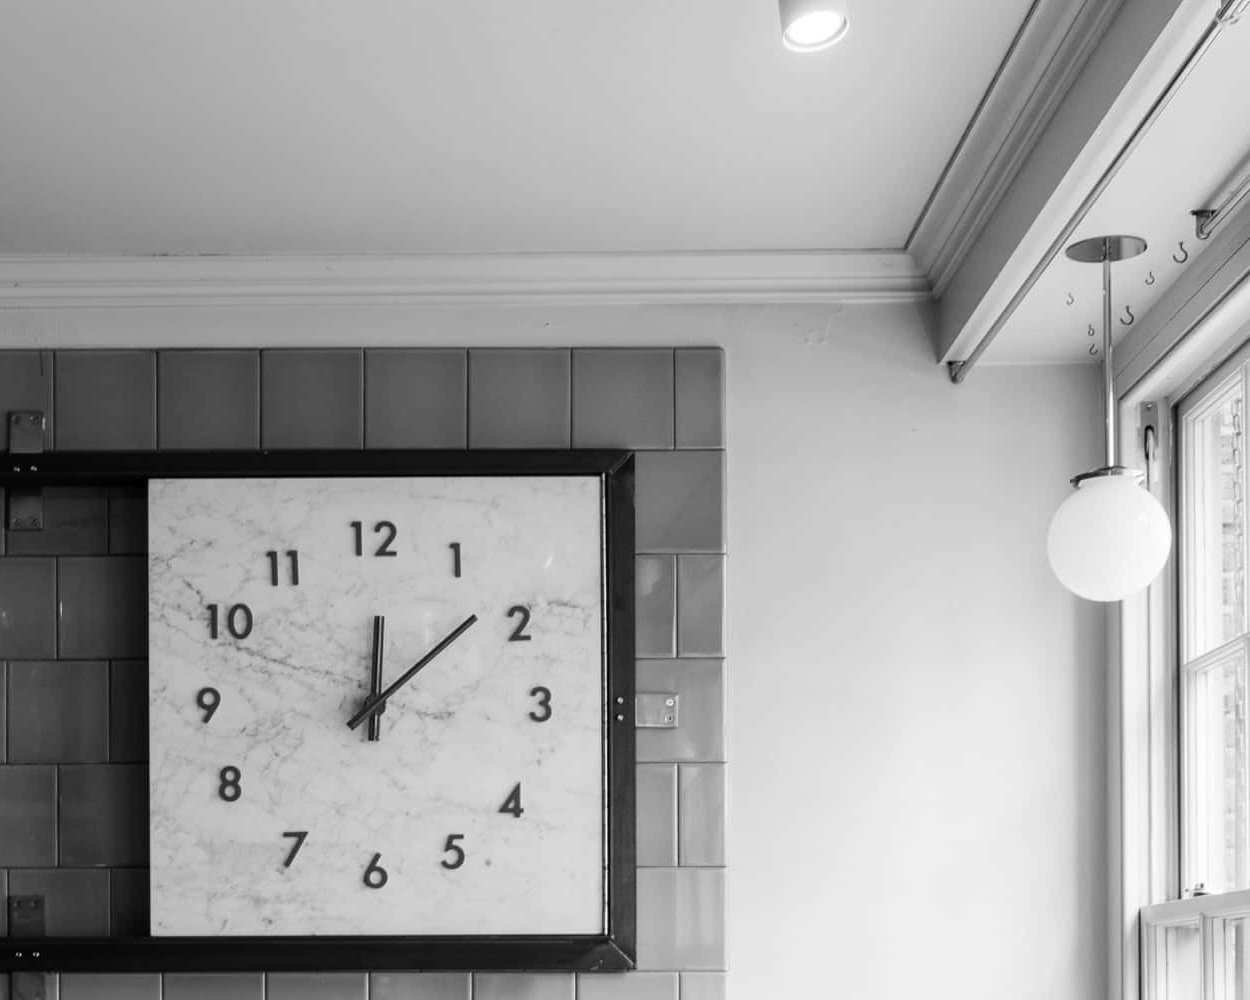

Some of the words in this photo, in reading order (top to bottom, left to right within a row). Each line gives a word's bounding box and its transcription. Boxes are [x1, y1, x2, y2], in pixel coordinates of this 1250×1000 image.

[350, 520, 397, 557] 12
[265, 549, 299, 586] 11
[449, 542, 461, 578] 1
[205, 603, 254, 640] 10
[506, 605, 532, 642] 2
[196, 687, 221, 724] 9
[529, 686, 552, 723] 3
[218, 765, 242, 803] 8
[498, 782, 524, 818] 4
[282, 831, 309, 868] 7
[440, 834, 465, 870] 5
[362, 852, 388, 889] 6
